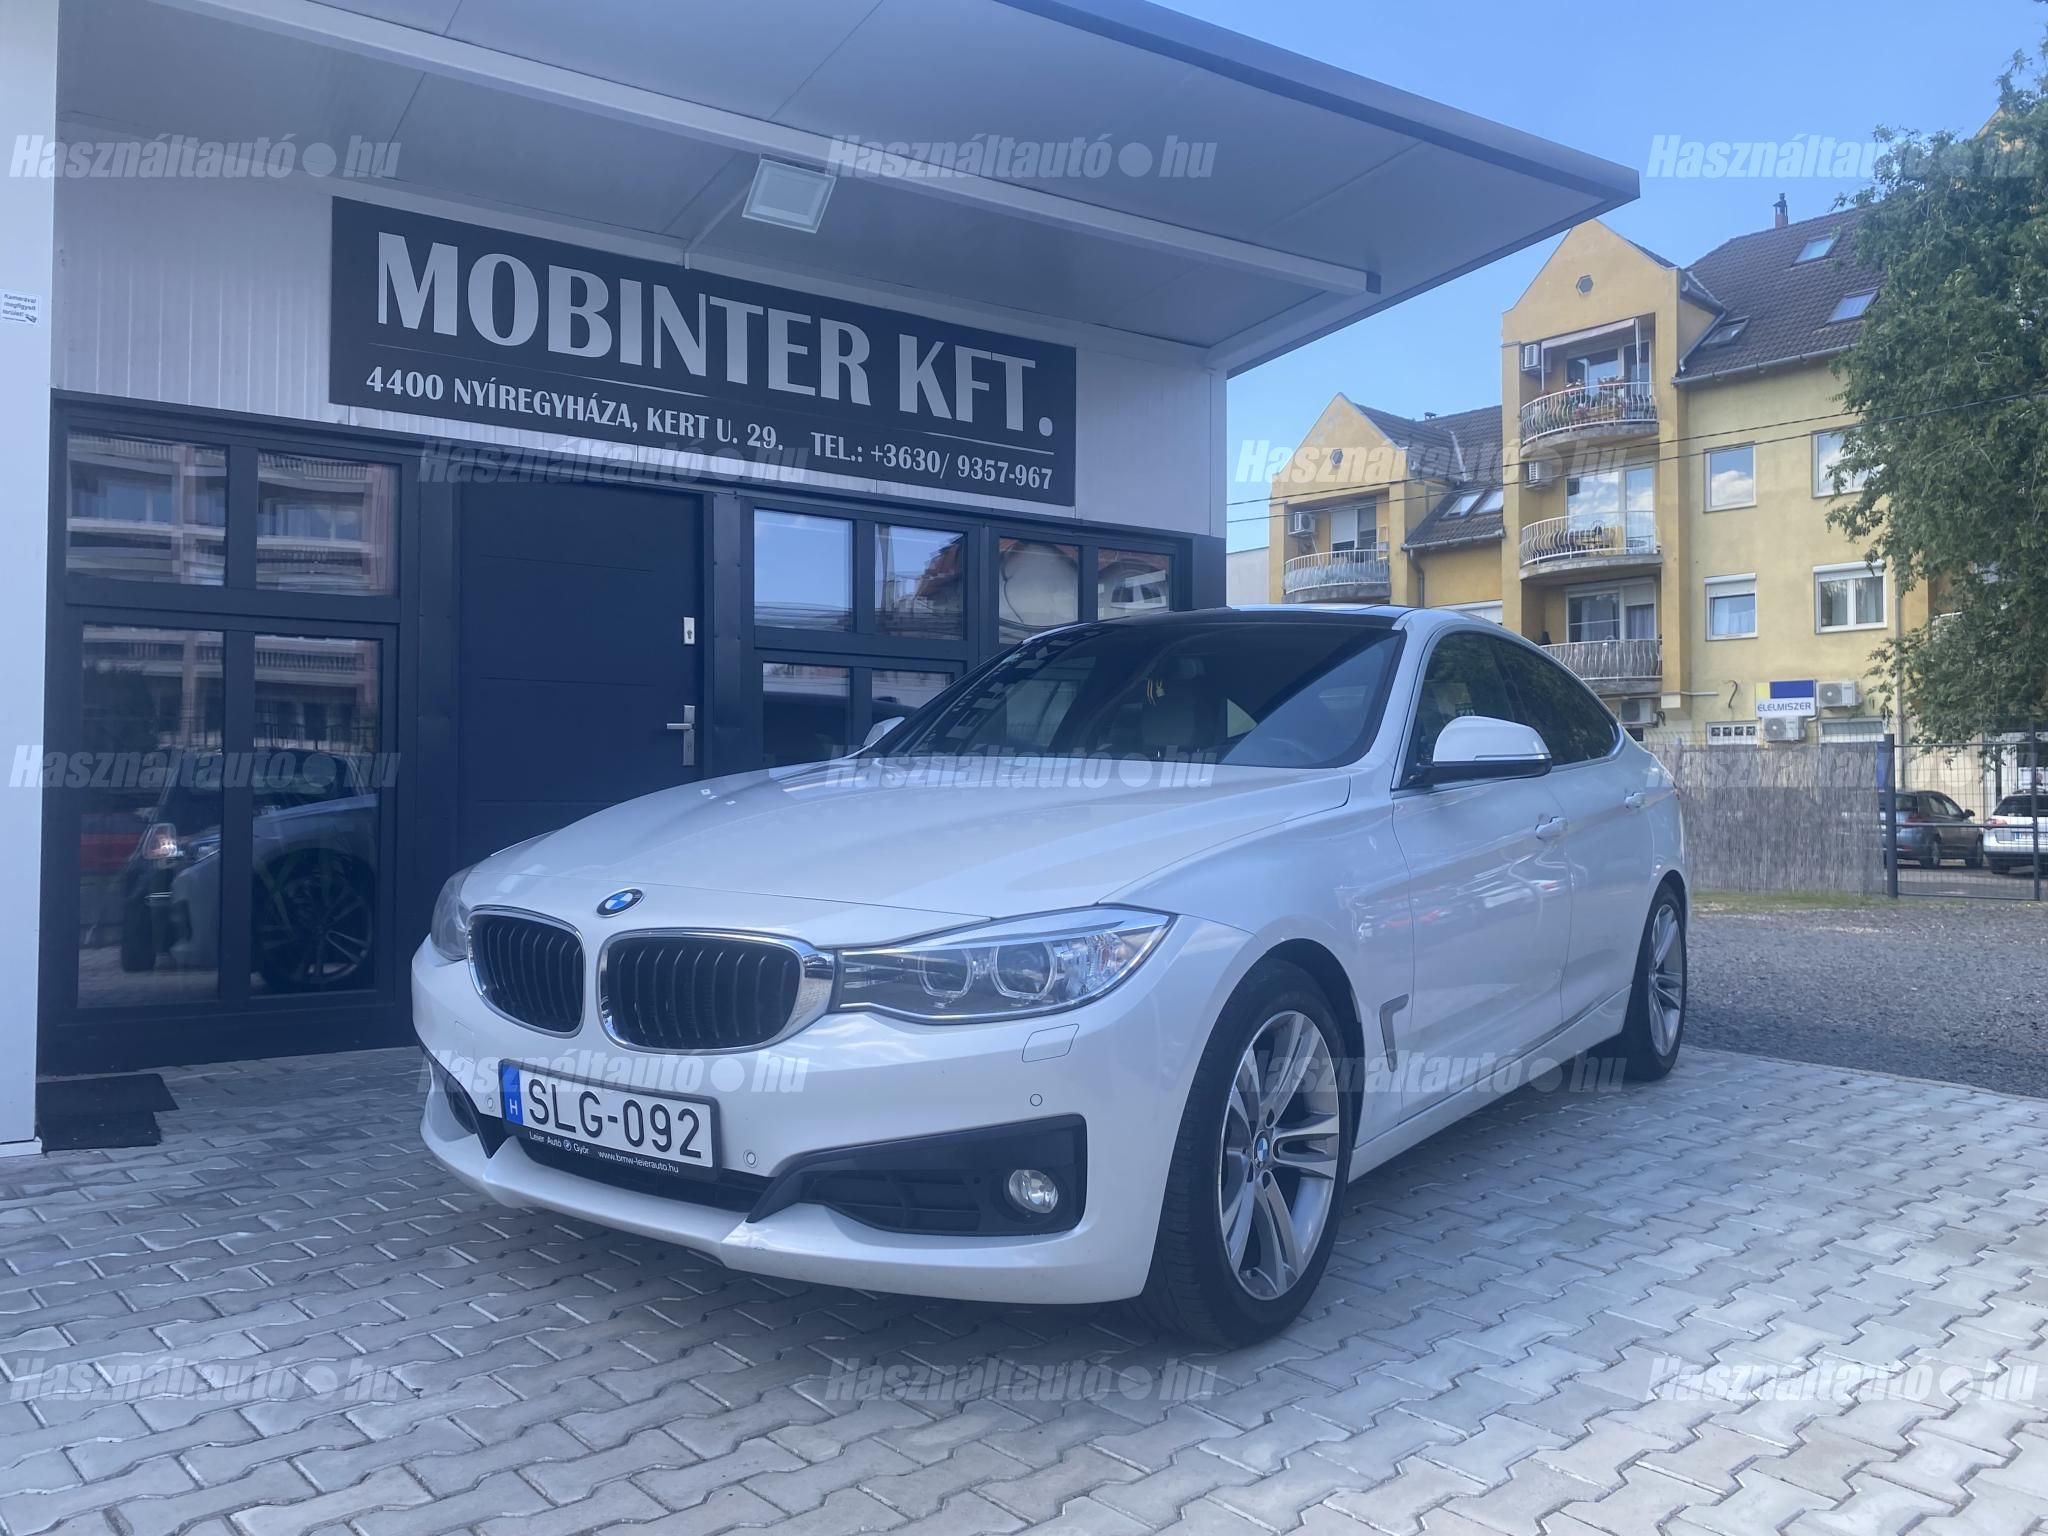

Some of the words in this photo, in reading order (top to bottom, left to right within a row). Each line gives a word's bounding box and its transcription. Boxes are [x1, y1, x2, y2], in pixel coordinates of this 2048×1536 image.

[378, 231, 872, 407] MOBINTER
[898, 333, 1054, 437] KFT.
[366, 366, 444, 401] 4400
[453, 376, 638, 433] NYÍREGYHÁZA,
[646, 408, 709, 440] KERT
[717, 417, 738, 445] U.
[747, 422, 785, 451] 29.
[811, 431, 864, 464] TEL.:
[870, 440, 949, 480] +3630/
[957, 454, 1053, 490] 9357-967
[509, 1099, 519, 1116] H
[528, 1078, 702, 1159] SLG-092
[597, 1151, 679, 1174] www.bmw-leierauto.hu
